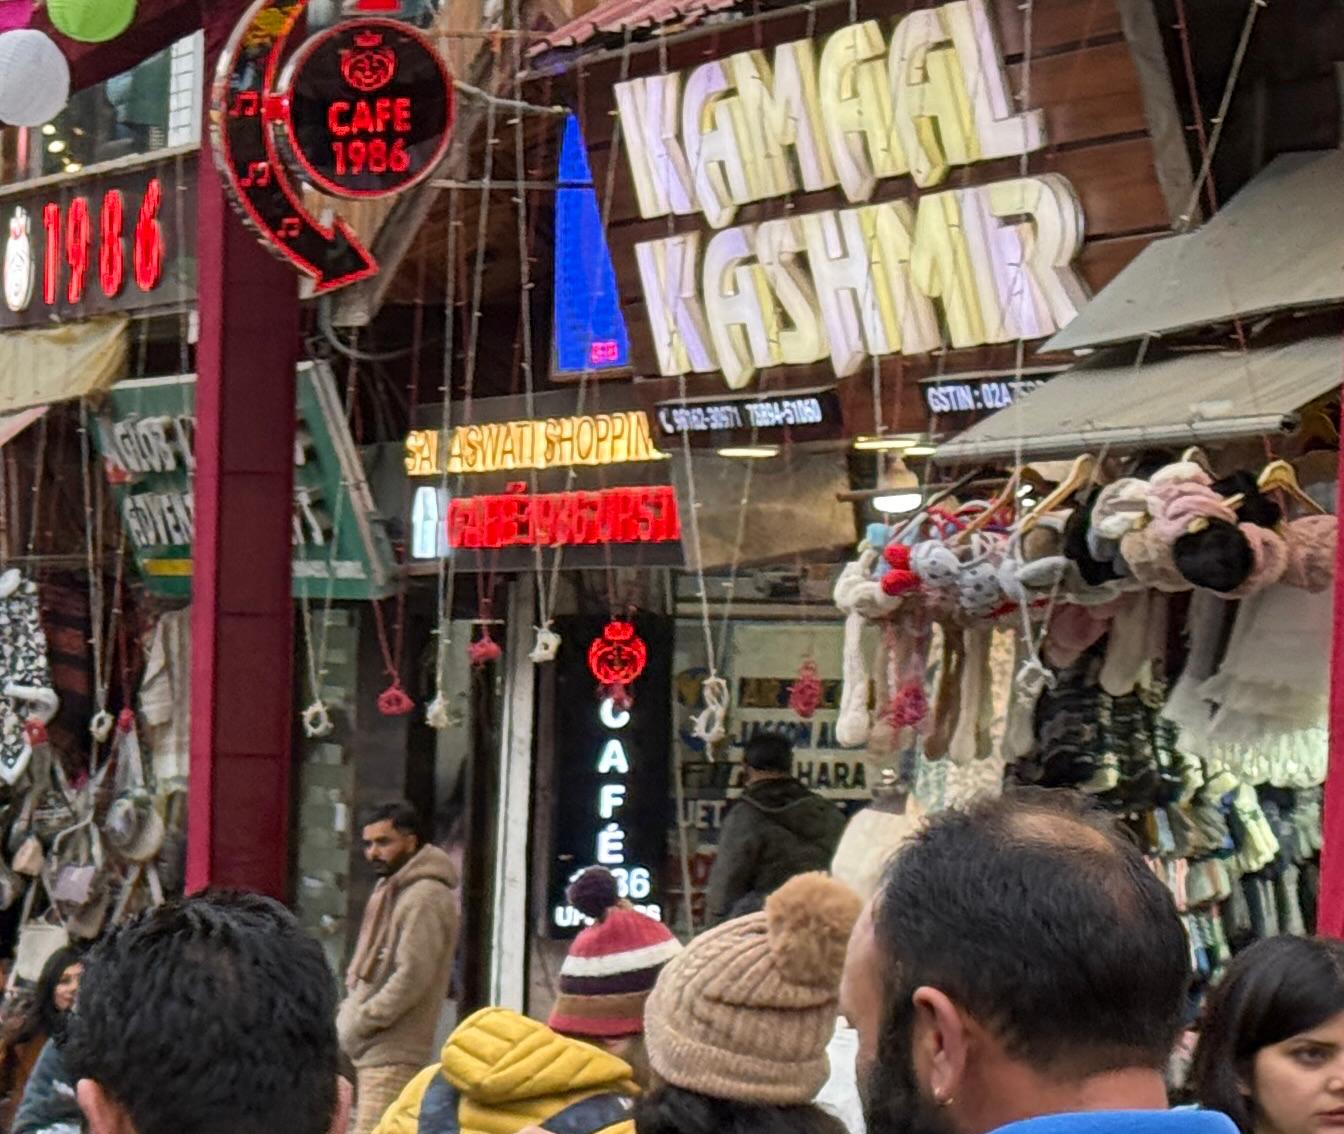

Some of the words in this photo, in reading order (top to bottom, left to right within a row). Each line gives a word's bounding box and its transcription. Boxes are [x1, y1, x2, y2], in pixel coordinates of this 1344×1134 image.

[328, 98, 411, 135] CAFE
[615, 0, 1045, 228] KAMAAL
[332, 139, 410, 175] 1986
[43, 178, 164, 304] 1986
